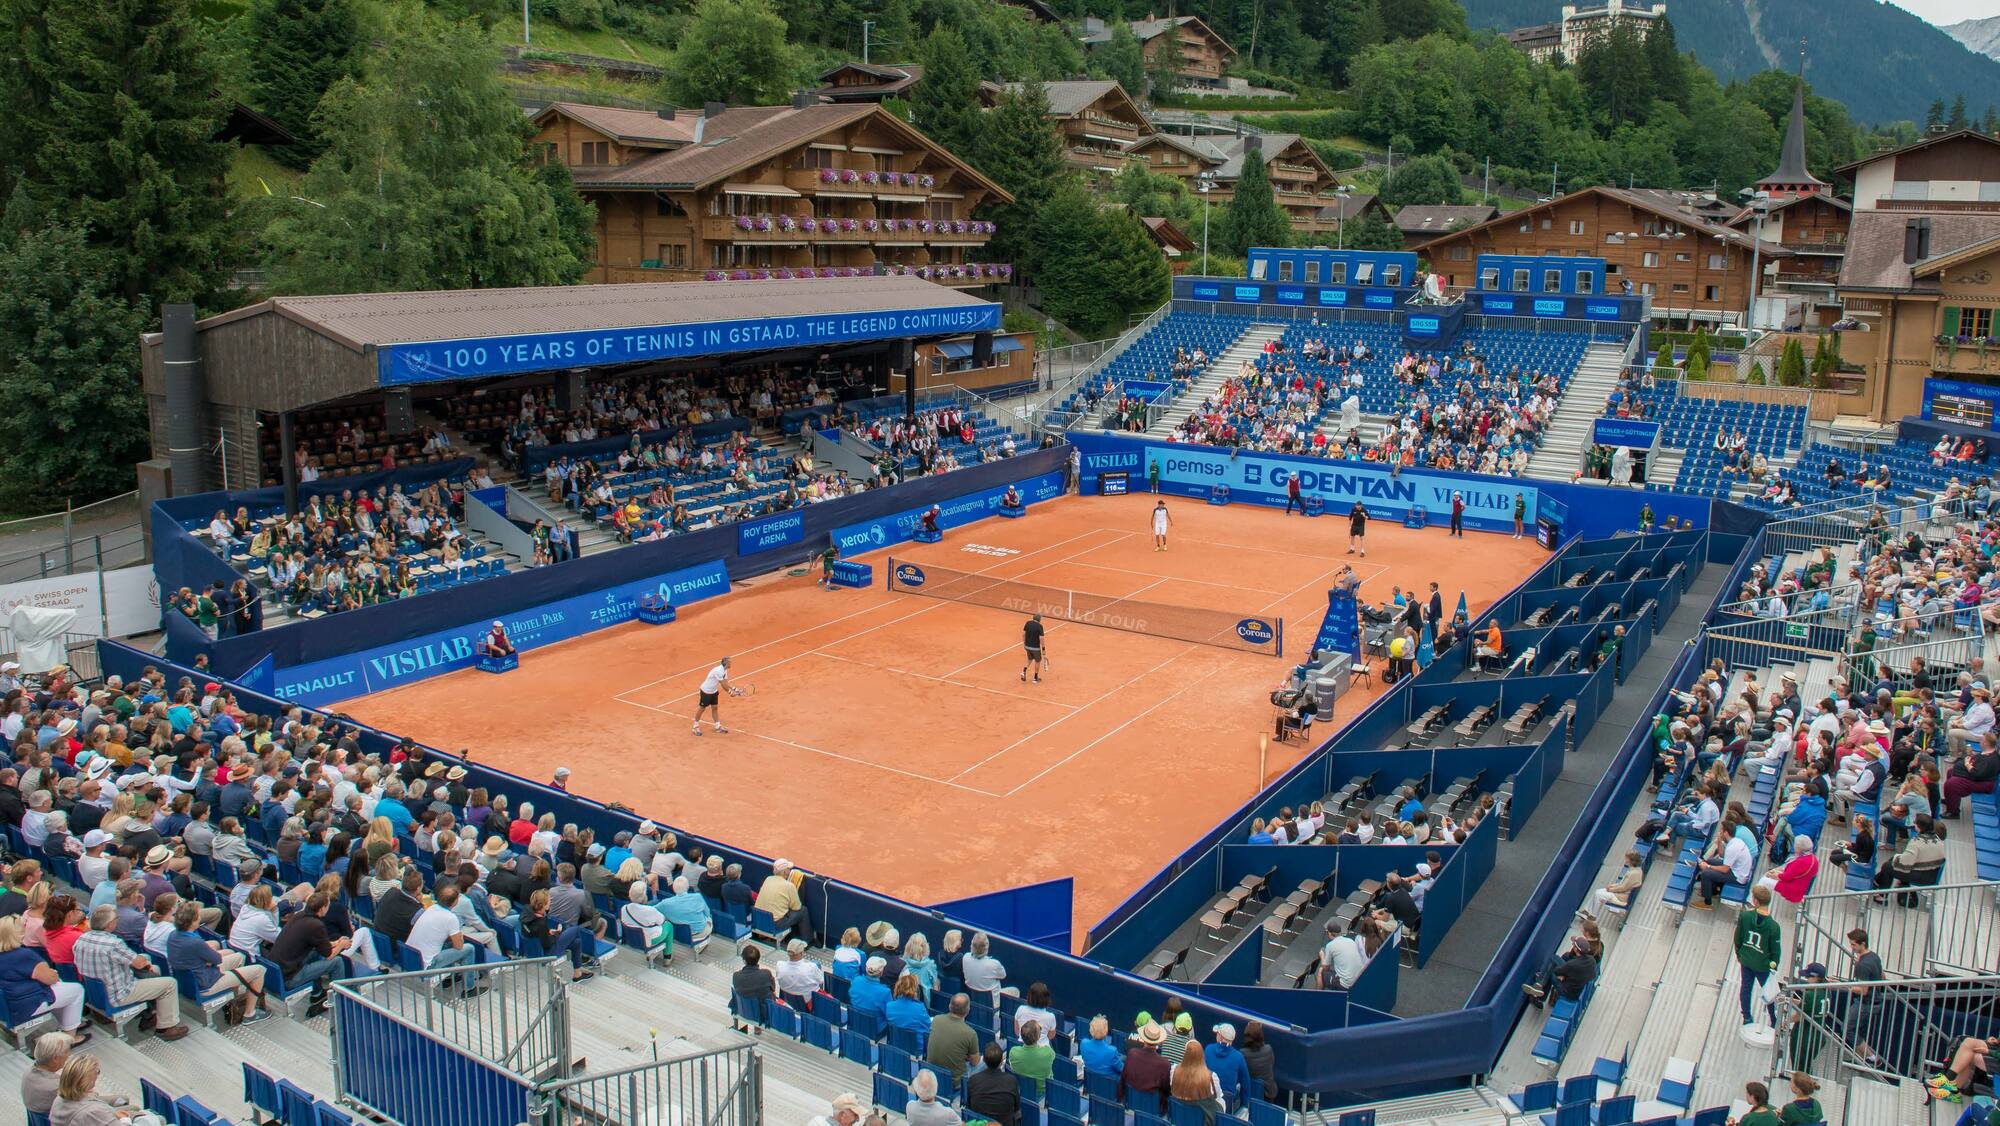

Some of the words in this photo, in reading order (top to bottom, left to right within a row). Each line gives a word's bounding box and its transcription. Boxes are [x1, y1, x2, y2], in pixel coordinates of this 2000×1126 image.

[444, 348, 487, 368] 100
[499, 341, 575, 363] YEARS
[586, 337, 613, 356] OF
[623, 331, 695, 353] TENNIS
[703, 329, 721, 346] IN
[729, 325, 800, 344] GSTAAD.
[807, 321, 836, 336] THE
[842, 317, 897, 334] LEGEND
[902, 311, 977, 329] CONTINUES!
[1087, 453, 1138, 469] VISILAB
[1166, 459, 1224, 476] pemsa
[840, 530, 871, 548] xerox
[940, 498, 985, 517] locationgroup
[1036, 484, 1058, 496] ZENITH
[743, 526, 762, 539] ROY
[762, 516, 800, 534] EMERSON
[758, 532, 787, 547] ARENA
[897, 570, 924, 582] Corona
[34, 590, 62, 601] SWISS
[63, 586, 88, 596] OPEN
[34, 597, 70, 608] GSTAAD
[600, 611, 632, 624] WATCHES
[1000, 597, 1032, 611] ATP
[1037, 601, 1096, 622] WORLD
[1101, 612, 1149, 631] TOUR
[1237, 626, 1272, 639] Corona
[1325, 624, 1340, 632] VTX
[274, 670, 355, 699] RENAULT
[369, 636, 473, 680] VISILAB
[590, 600, 637, 620] ZENITH
[673, 573, 722, 594] RENAULT
[1320, 636, 1337, 645] VTX
